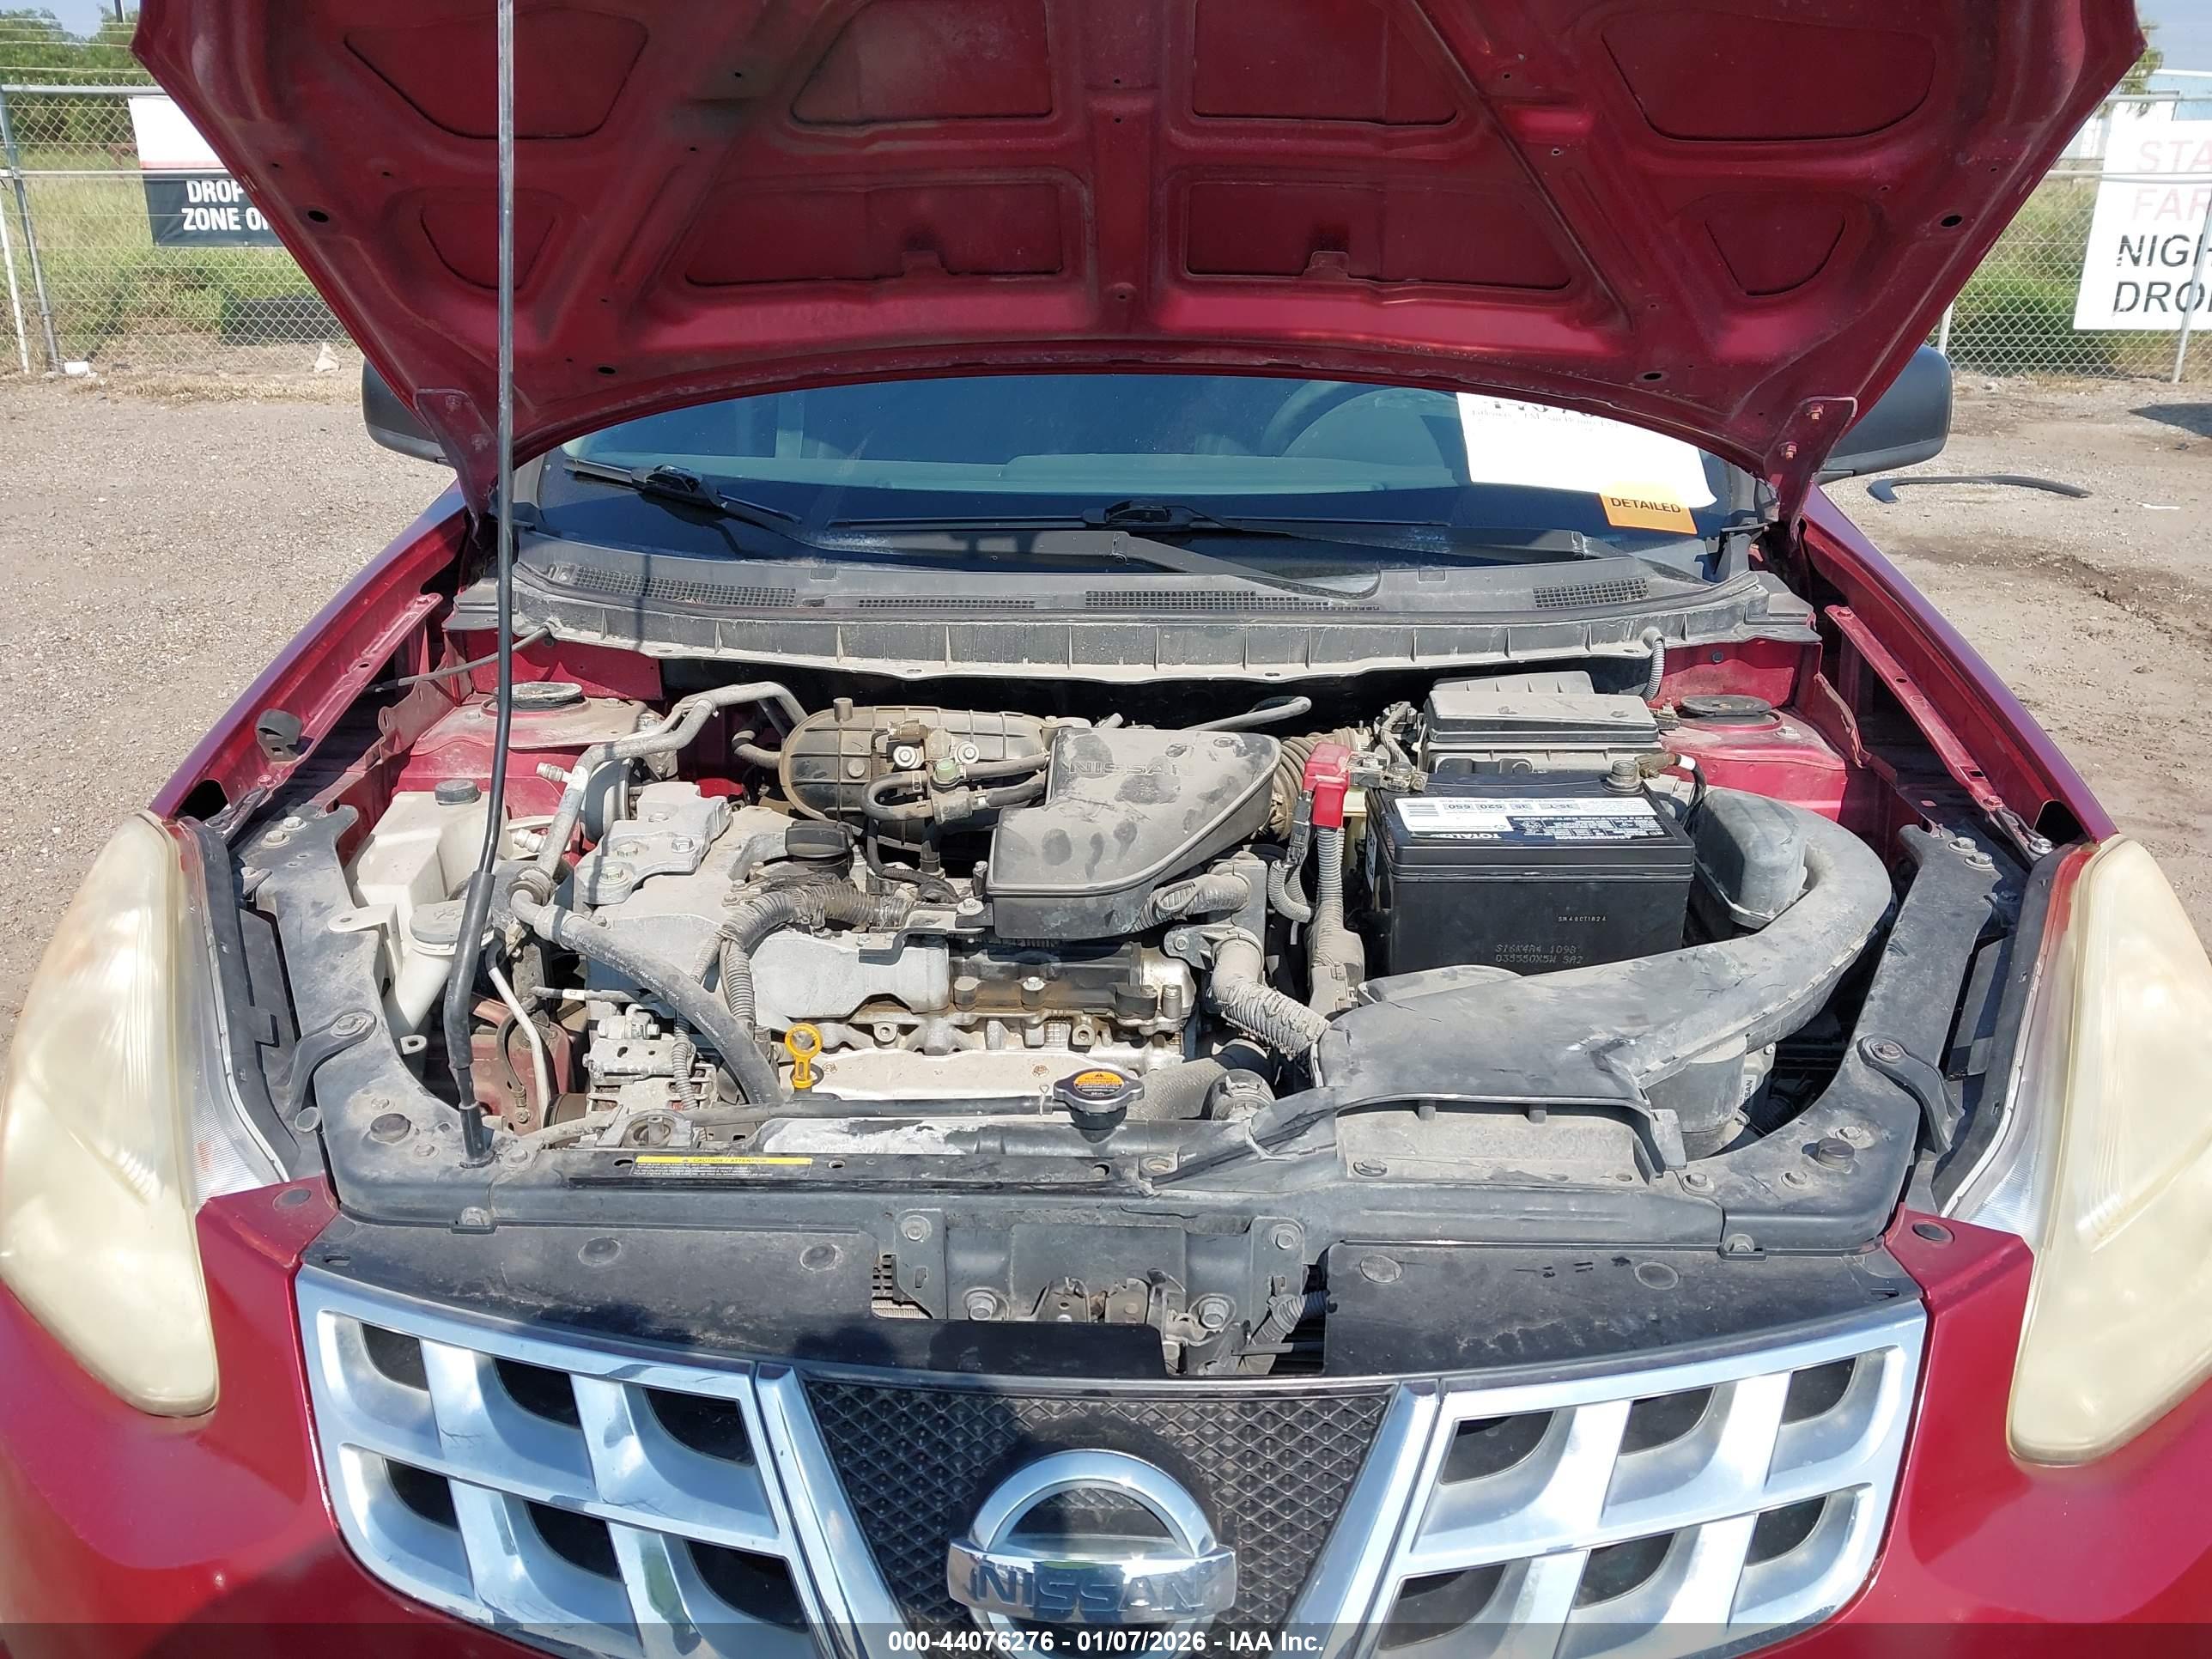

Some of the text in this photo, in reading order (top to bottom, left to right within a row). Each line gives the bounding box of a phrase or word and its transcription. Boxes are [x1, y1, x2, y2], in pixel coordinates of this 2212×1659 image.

[181, 208, 241, 230] ZONE
[1610, 498, 1680, 513] DETAILED
[969, 1565, 1206, 1613] NISSAN
